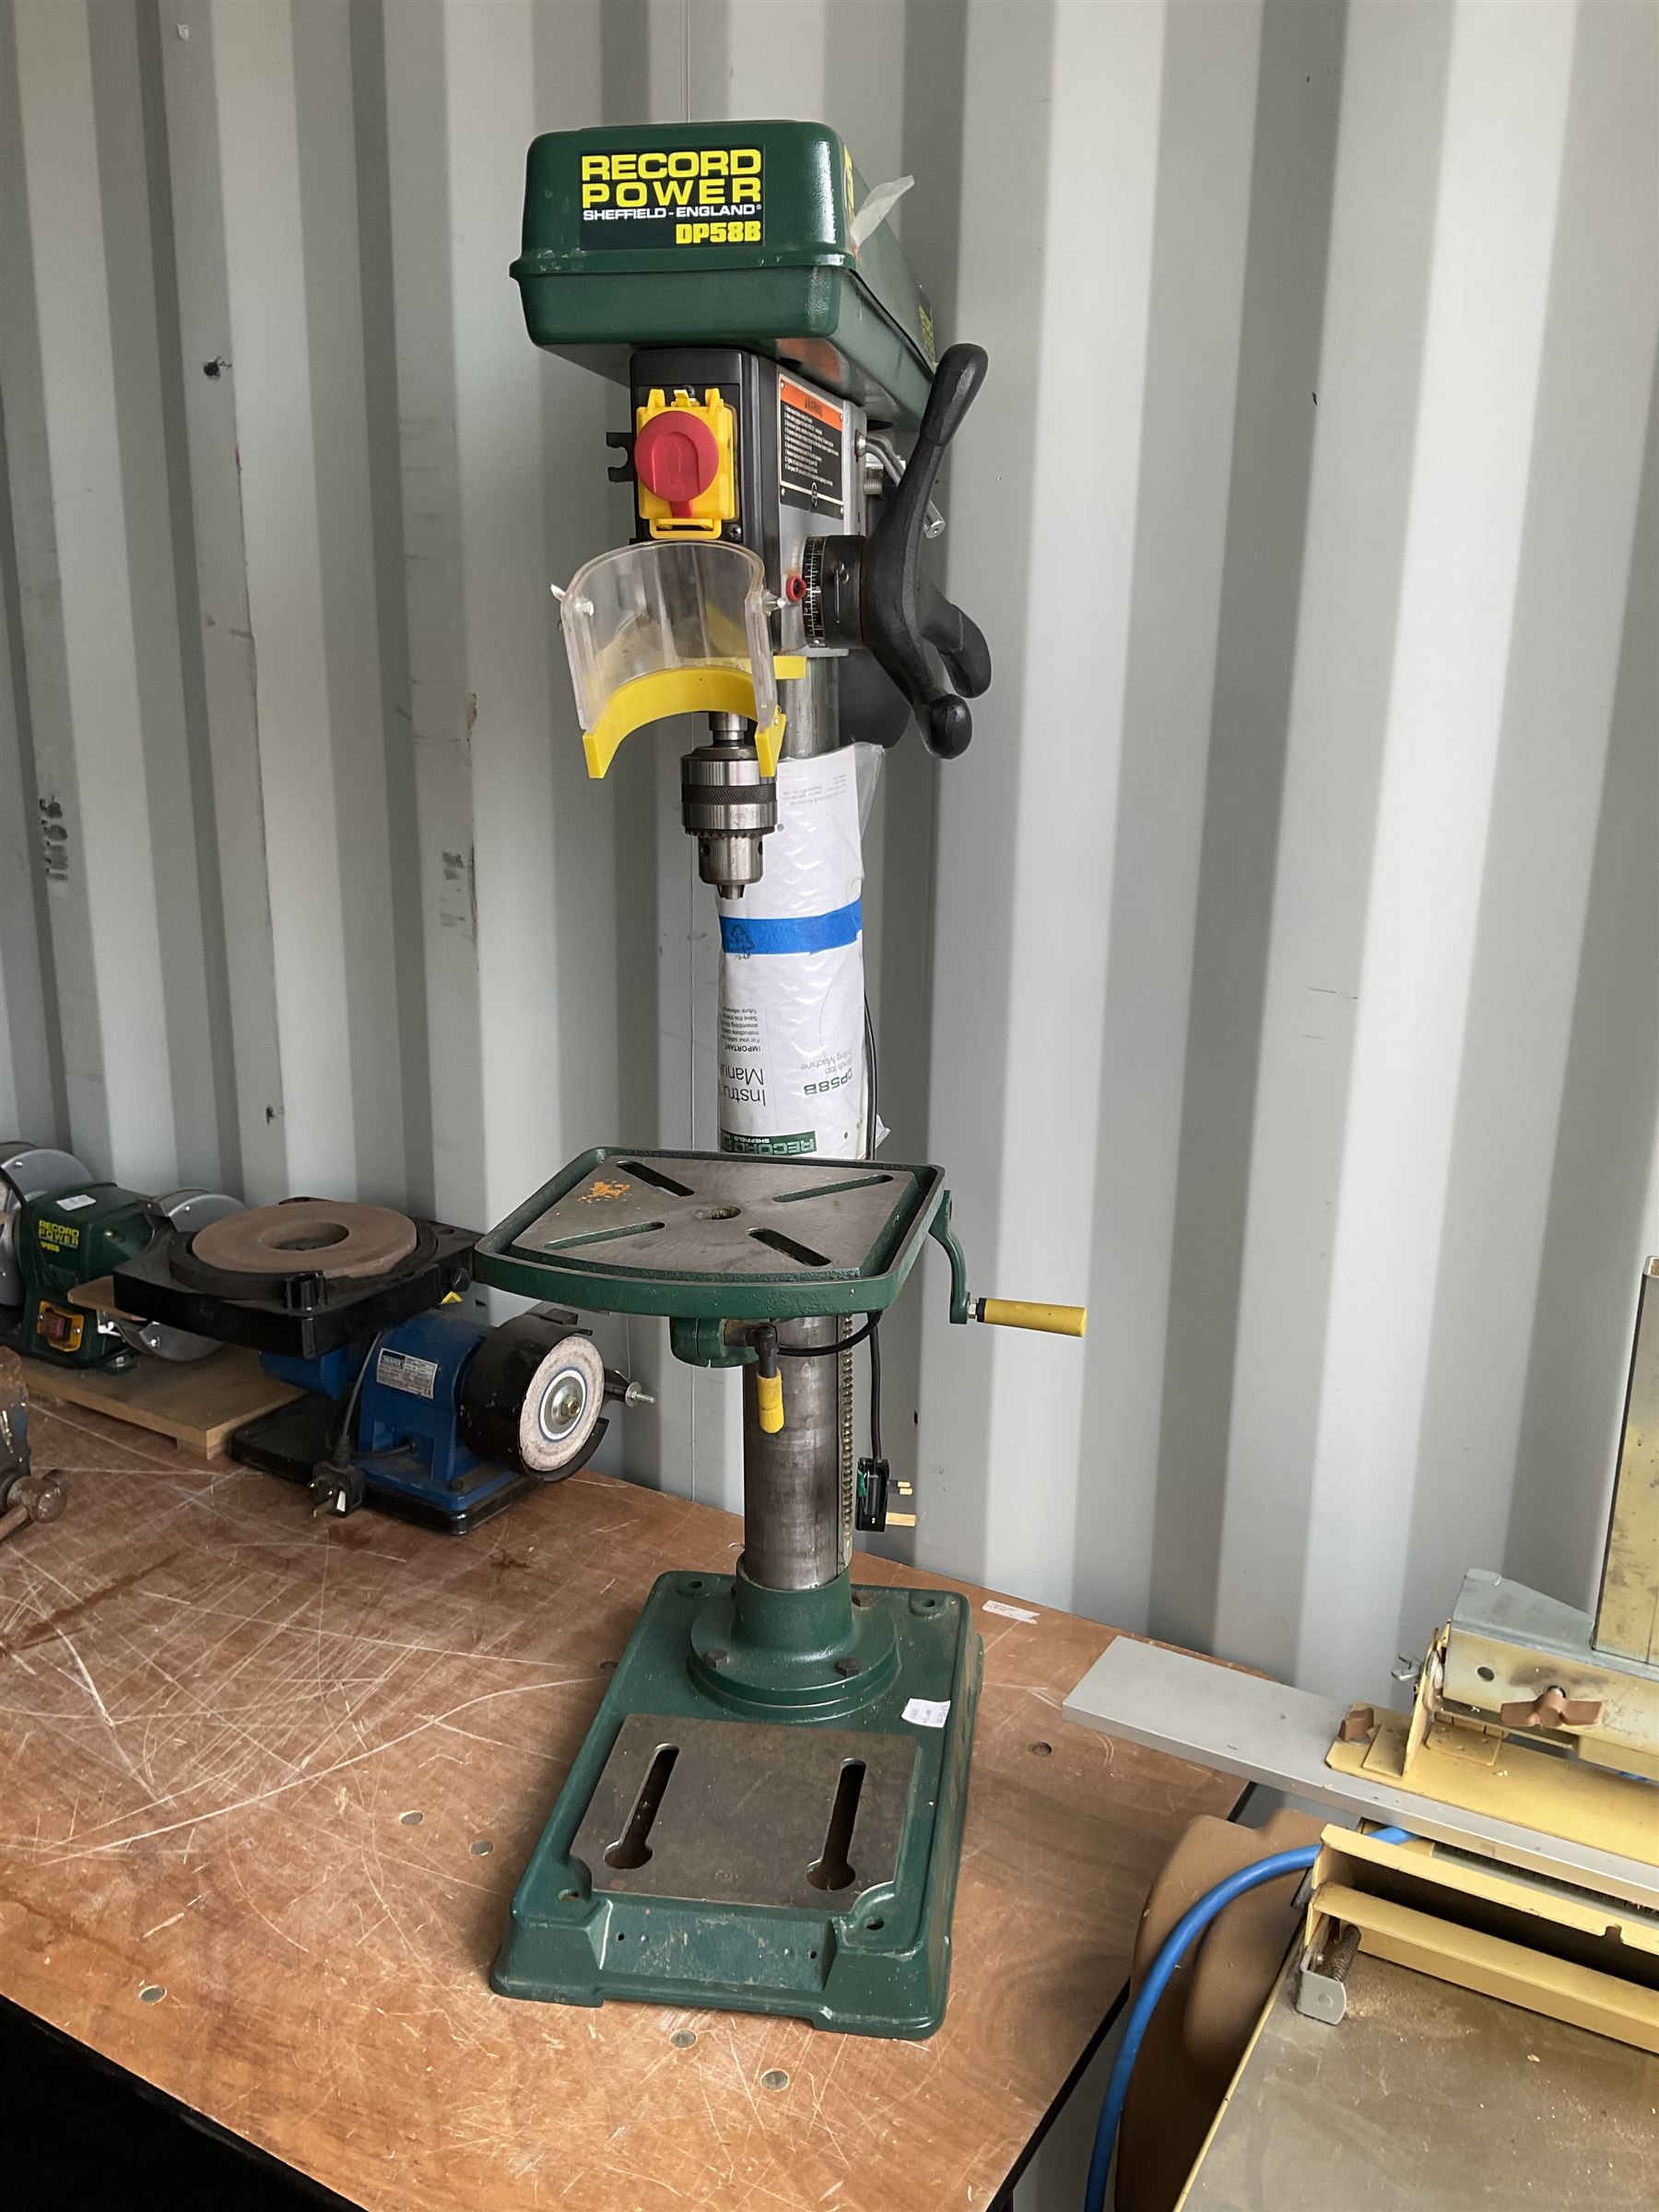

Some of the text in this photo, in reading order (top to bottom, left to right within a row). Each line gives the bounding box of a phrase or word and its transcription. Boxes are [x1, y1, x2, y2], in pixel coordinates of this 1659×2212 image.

[582, 148, 761, 182] RECORD
[582, 177, 761, 208] POWER
[583, 207, 666, 221] SHEFFIELD
[676, 220, 761, 244] DP58B
[724, 1043, 761, 1053] IMPORTANT
[801, 1054, 836, 1070] Machine
[825, 1065, 838, 1075] top
[803, 1067, 853, 1096] DP58B
[734, 1138, 814, 1155] RECORD
[39, 1227, 79, 1246] POWER
[40, 1219, 80, 1237] RECORD
